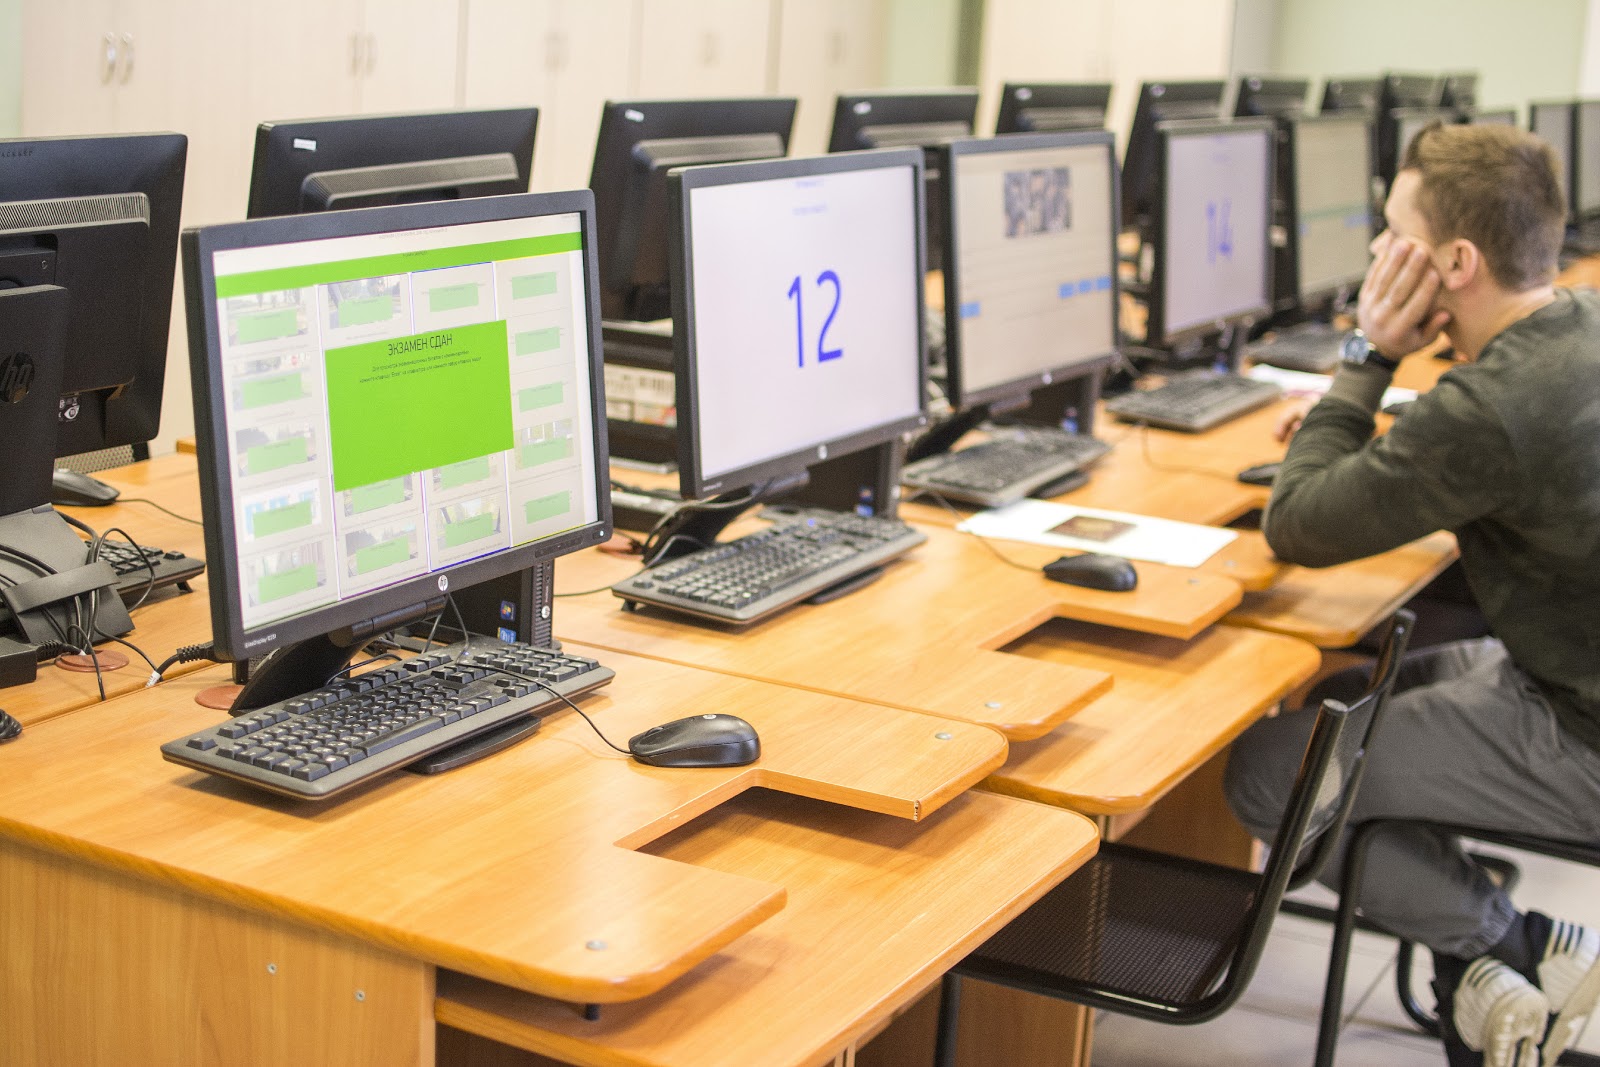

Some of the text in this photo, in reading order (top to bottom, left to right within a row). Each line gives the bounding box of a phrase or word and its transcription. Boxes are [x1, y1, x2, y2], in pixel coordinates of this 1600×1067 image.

[387, 340, 428, 356] ЭКЗАМЕН
[430, 333, 453, 349] СДАН
[787, 269, 844, 368] 12
